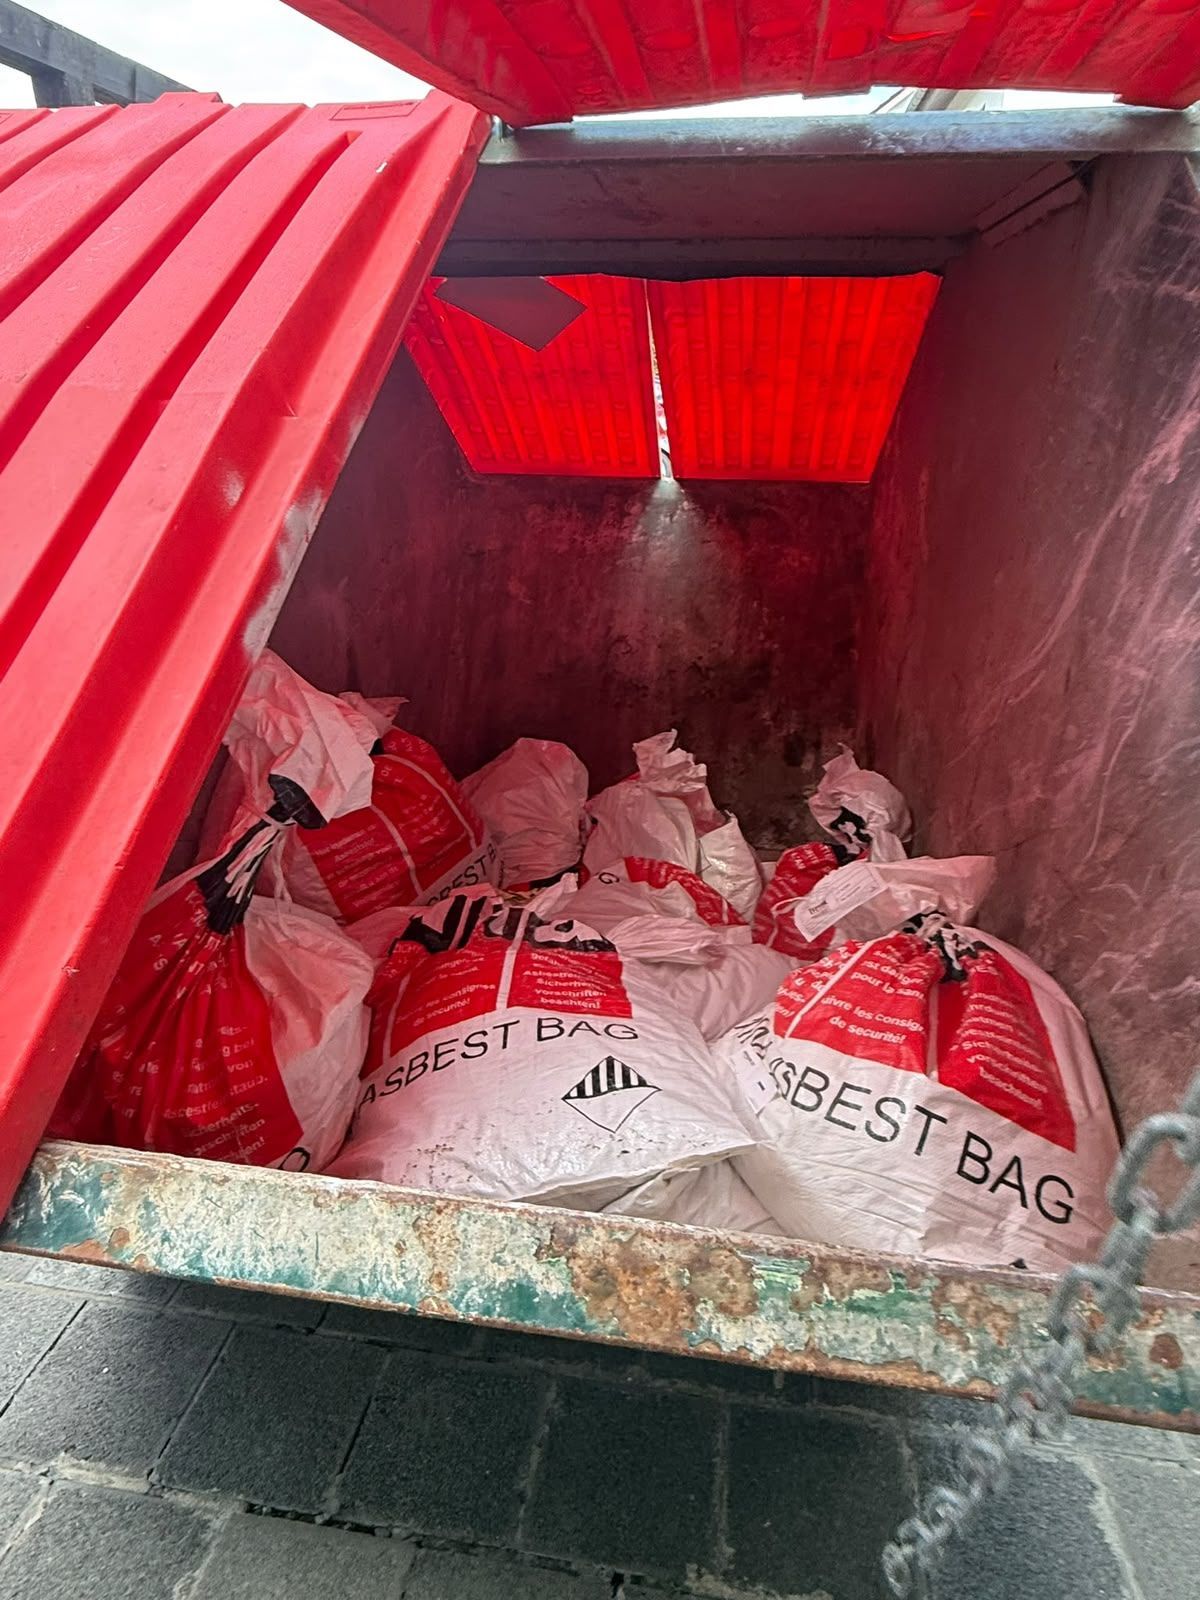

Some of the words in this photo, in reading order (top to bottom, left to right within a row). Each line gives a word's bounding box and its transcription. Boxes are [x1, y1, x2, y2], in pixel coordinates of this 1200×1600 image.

[828, 1015, 847, 1029] de
[853, 1005, 874, 1020] les
[358, 1019, 521, 1113] ASBEST
[536, 1017, 639, 1042] BAG
[955, 1130, 1076, 1225] BAG
